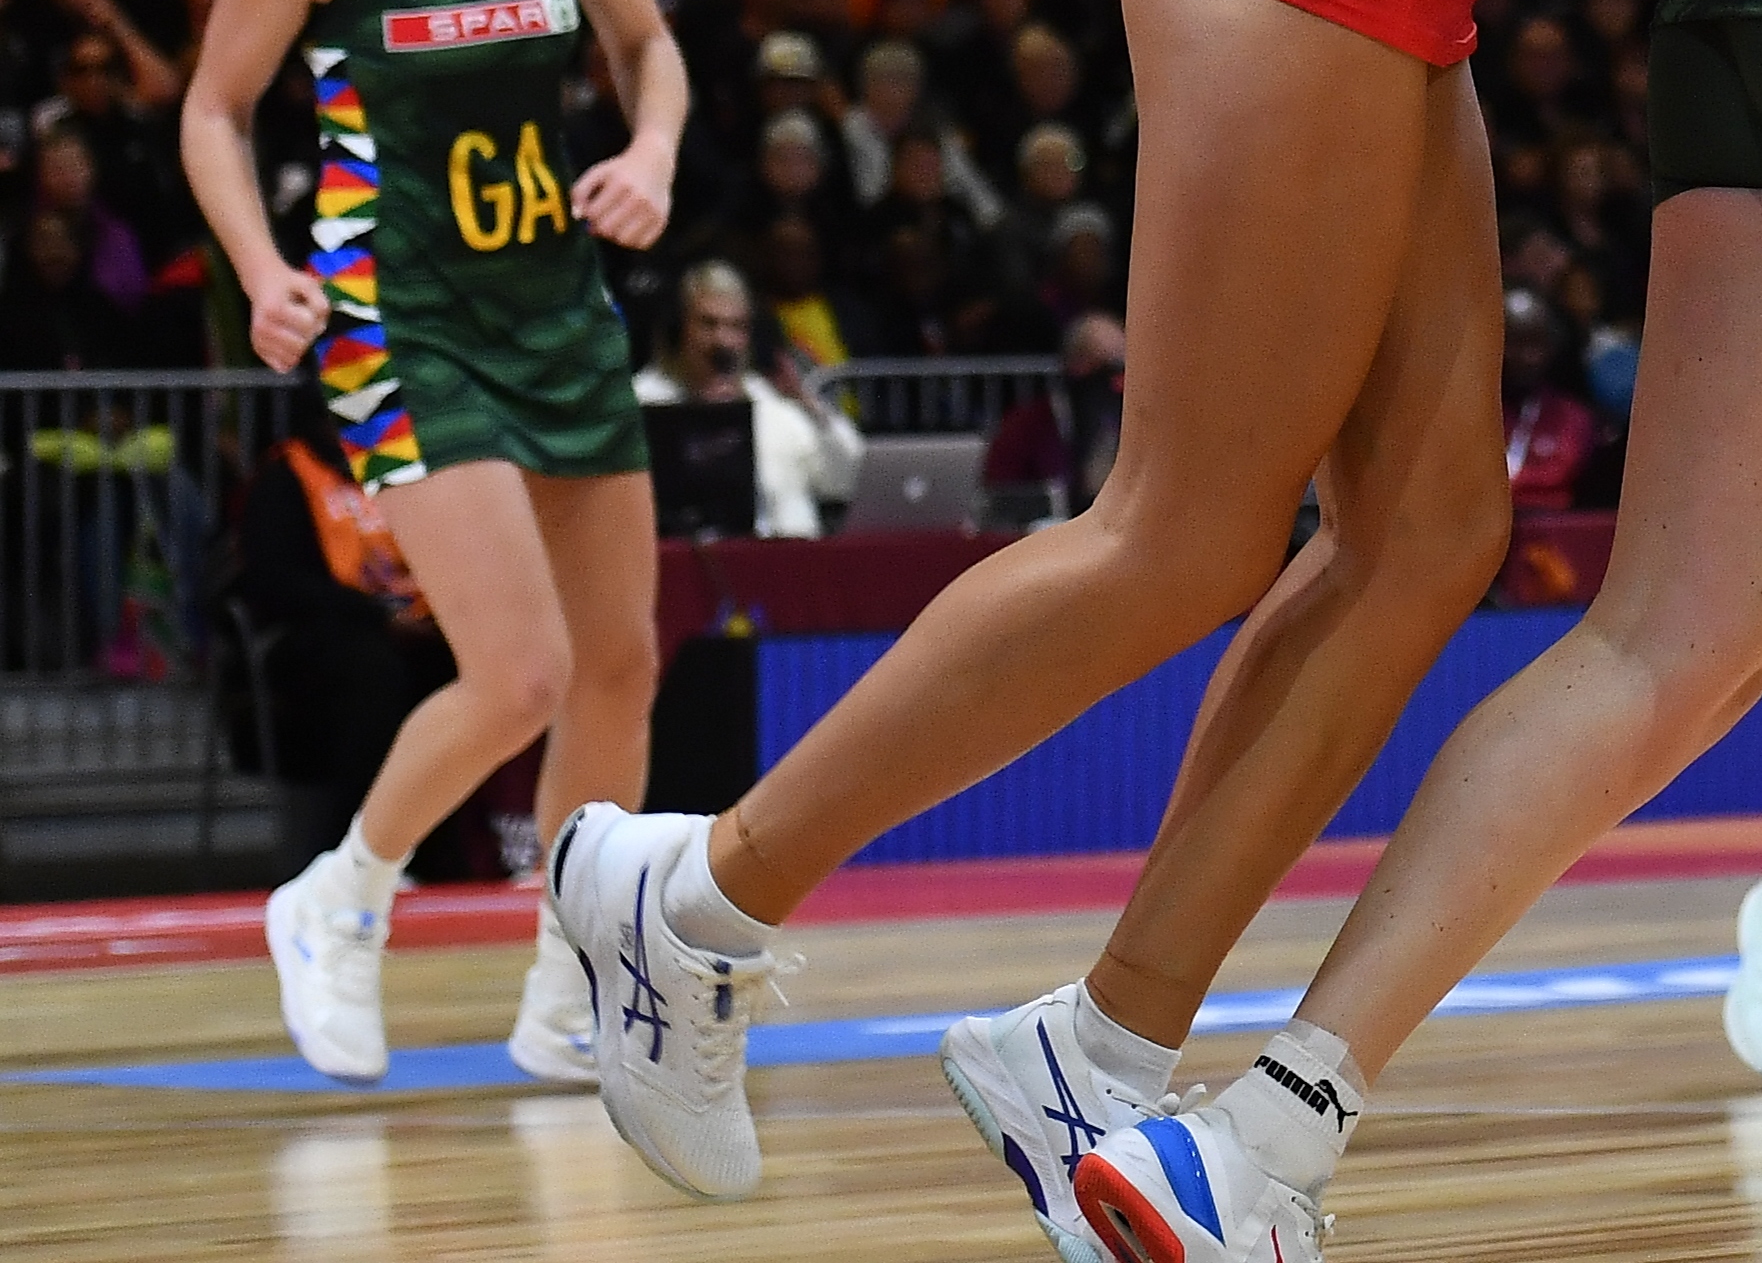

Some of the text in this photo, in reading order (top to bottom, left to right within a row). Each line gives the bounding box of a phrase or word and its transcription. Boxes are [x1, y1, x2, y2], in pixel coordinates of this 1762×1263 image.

[429, 0, 547, 41] SPAR
[448, 121, 567, 252] GA
[1253, 1053, 1330, 1117] PUMA
